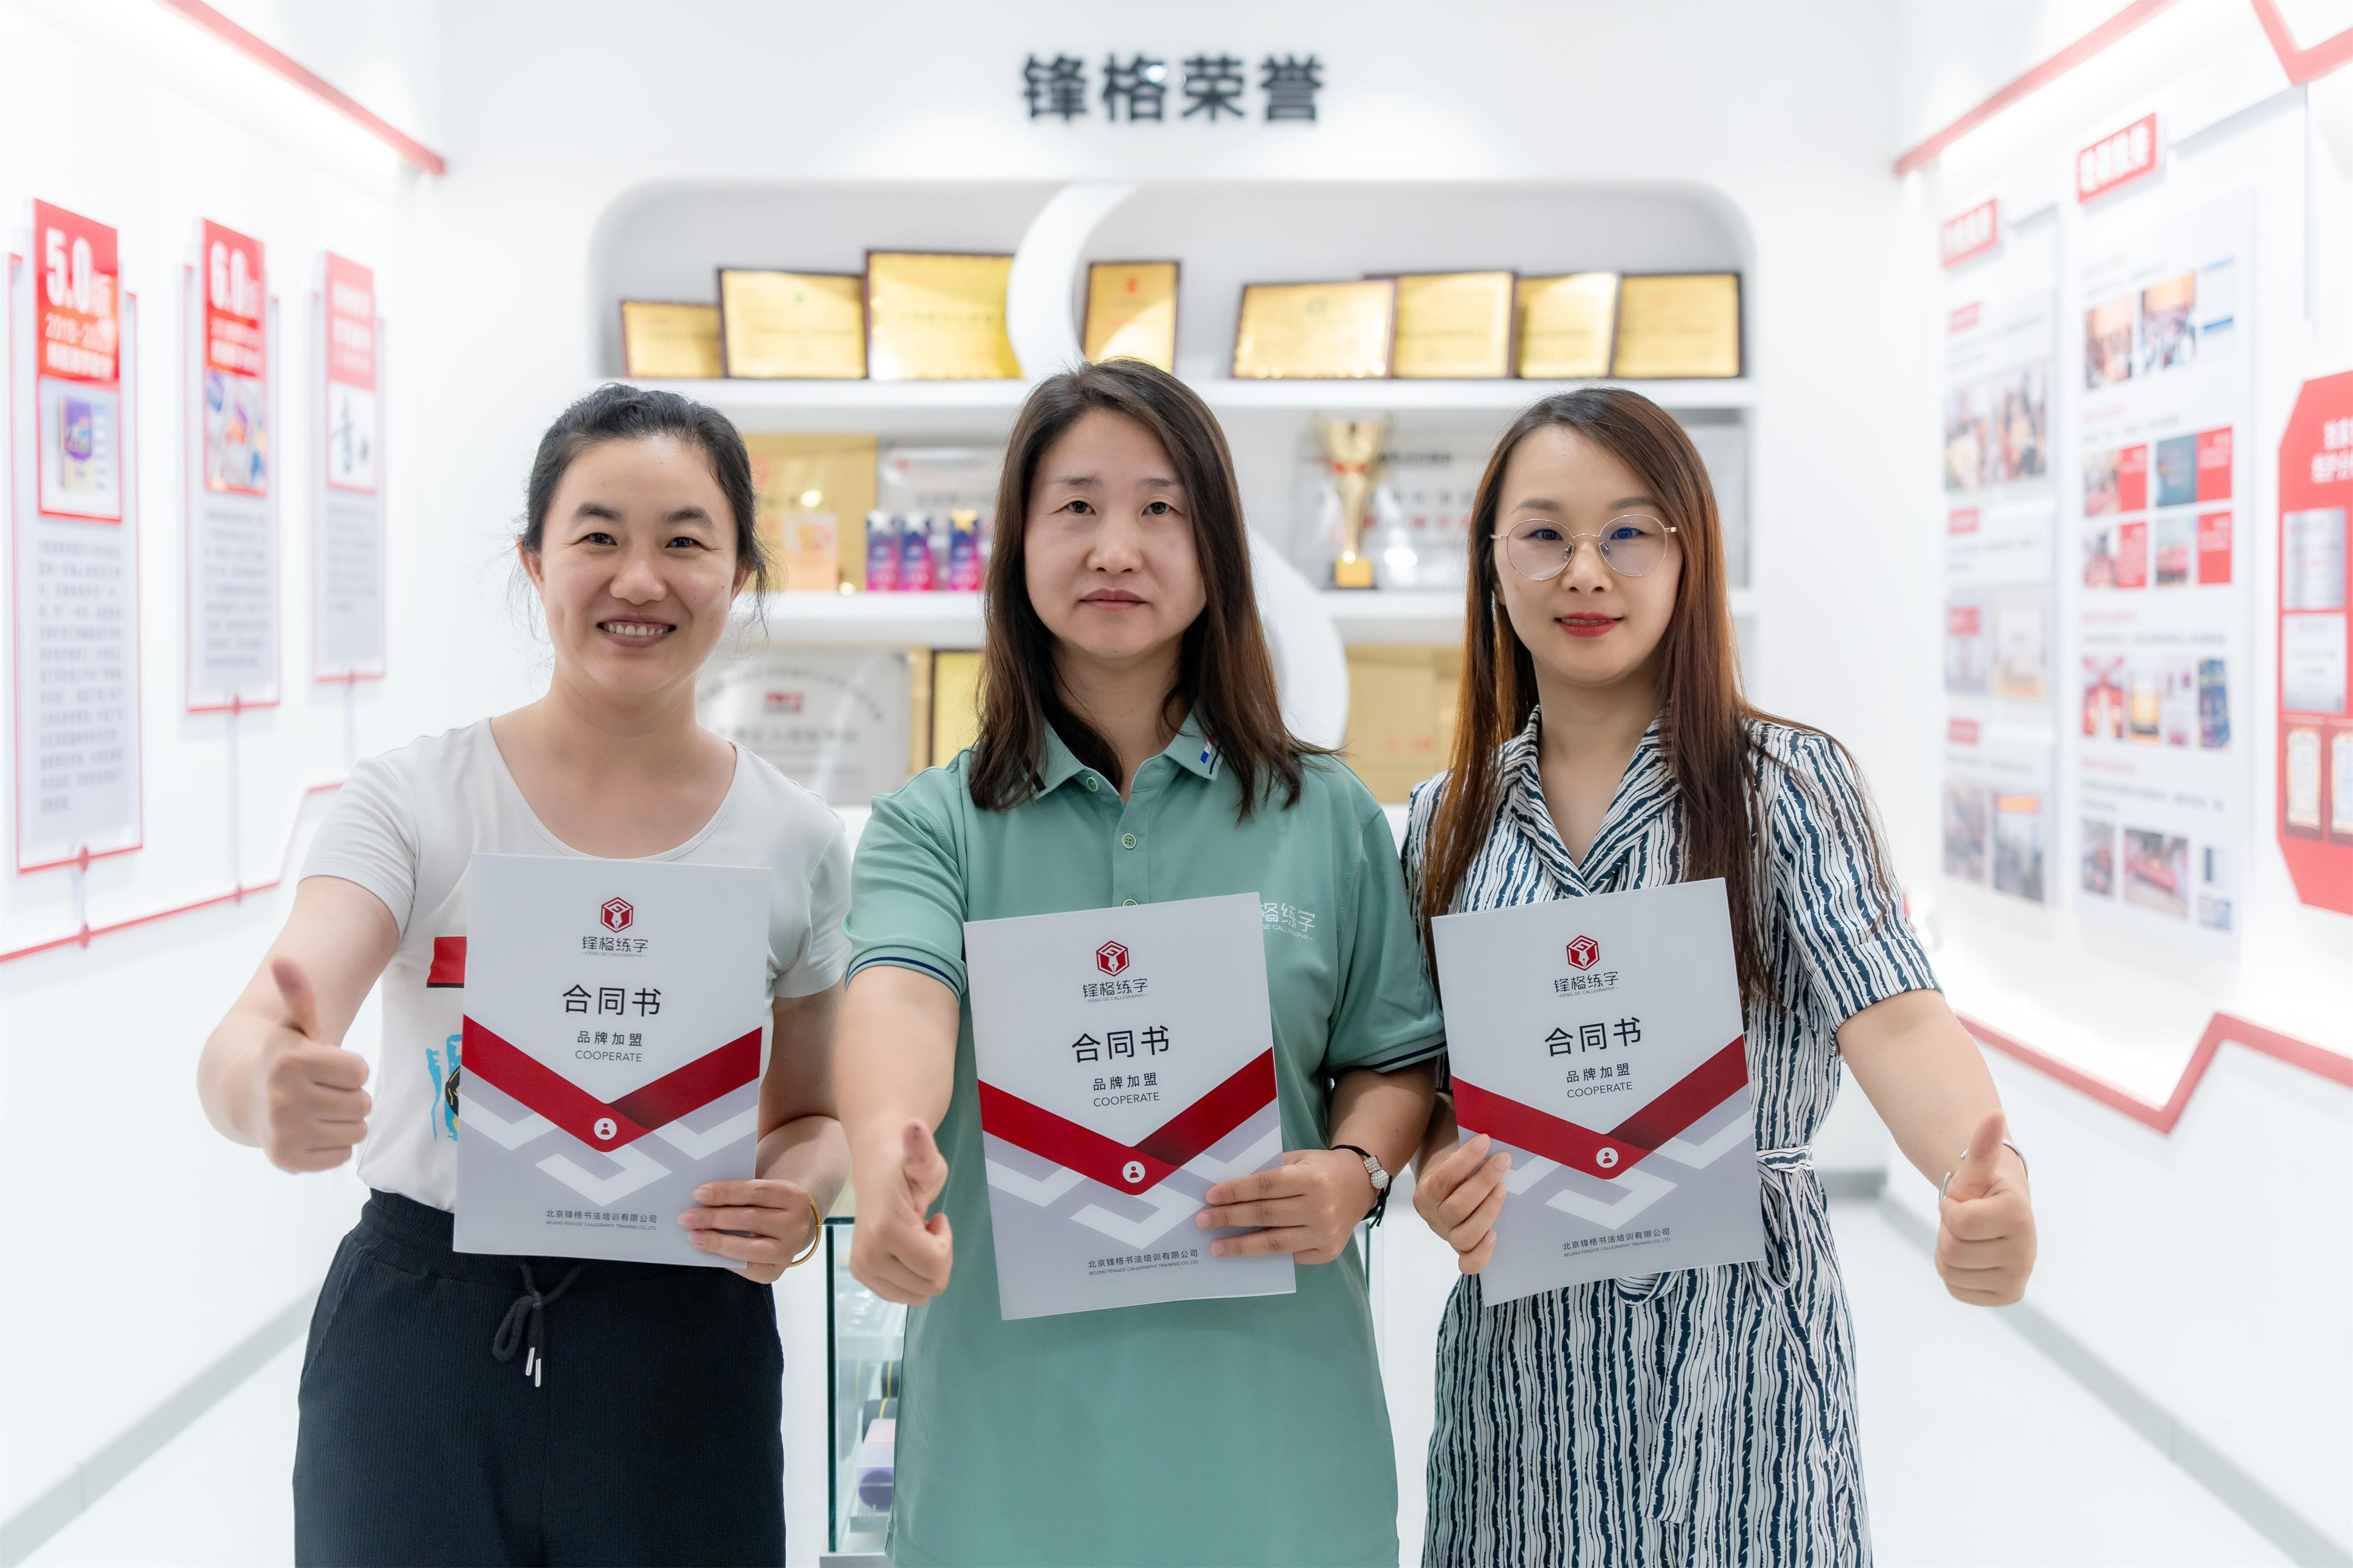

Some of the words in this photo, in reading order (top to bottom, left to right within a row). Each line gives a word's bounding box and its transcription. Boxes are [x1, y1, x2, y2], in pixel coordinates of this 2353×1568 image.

[1022, 54, 1322, 121] 锋格荣誉
[582, 936, 648, 952] 锋格练字
[1083, 978, 1148, 997] 锋格练字
[1554, 972, 1619, 993] 锋格练字
[1582, 986, 1615, 995] CALLIGRAPHY
[563, 985, 661, 1017] 合同书
[578, 1030, 642, 1046] 品牌加盟
[1072, 1025, 1169, 1063] 合同书
[1545, 1016, 1641, 1057] 合同书
[575, 1050, 642, 1062] COOPERATE
[1093, 1072, 1158, 1091] 品牌加盟
[1567, 1063, 1630, 1083] 品牌加盟
[1094, 1092, 1160, 1107] COOPERATE
[1567, 1082, 1633, 1098] COOPERATE
[546, 1210, 657, 1223] 北京锋格书法培训有限公司
[1562, 1227, 1670, 1250] 北京锋格书法培训有限公司
[1088, 1249, 1198, 1268] 北京锋格书法培训有限公司
